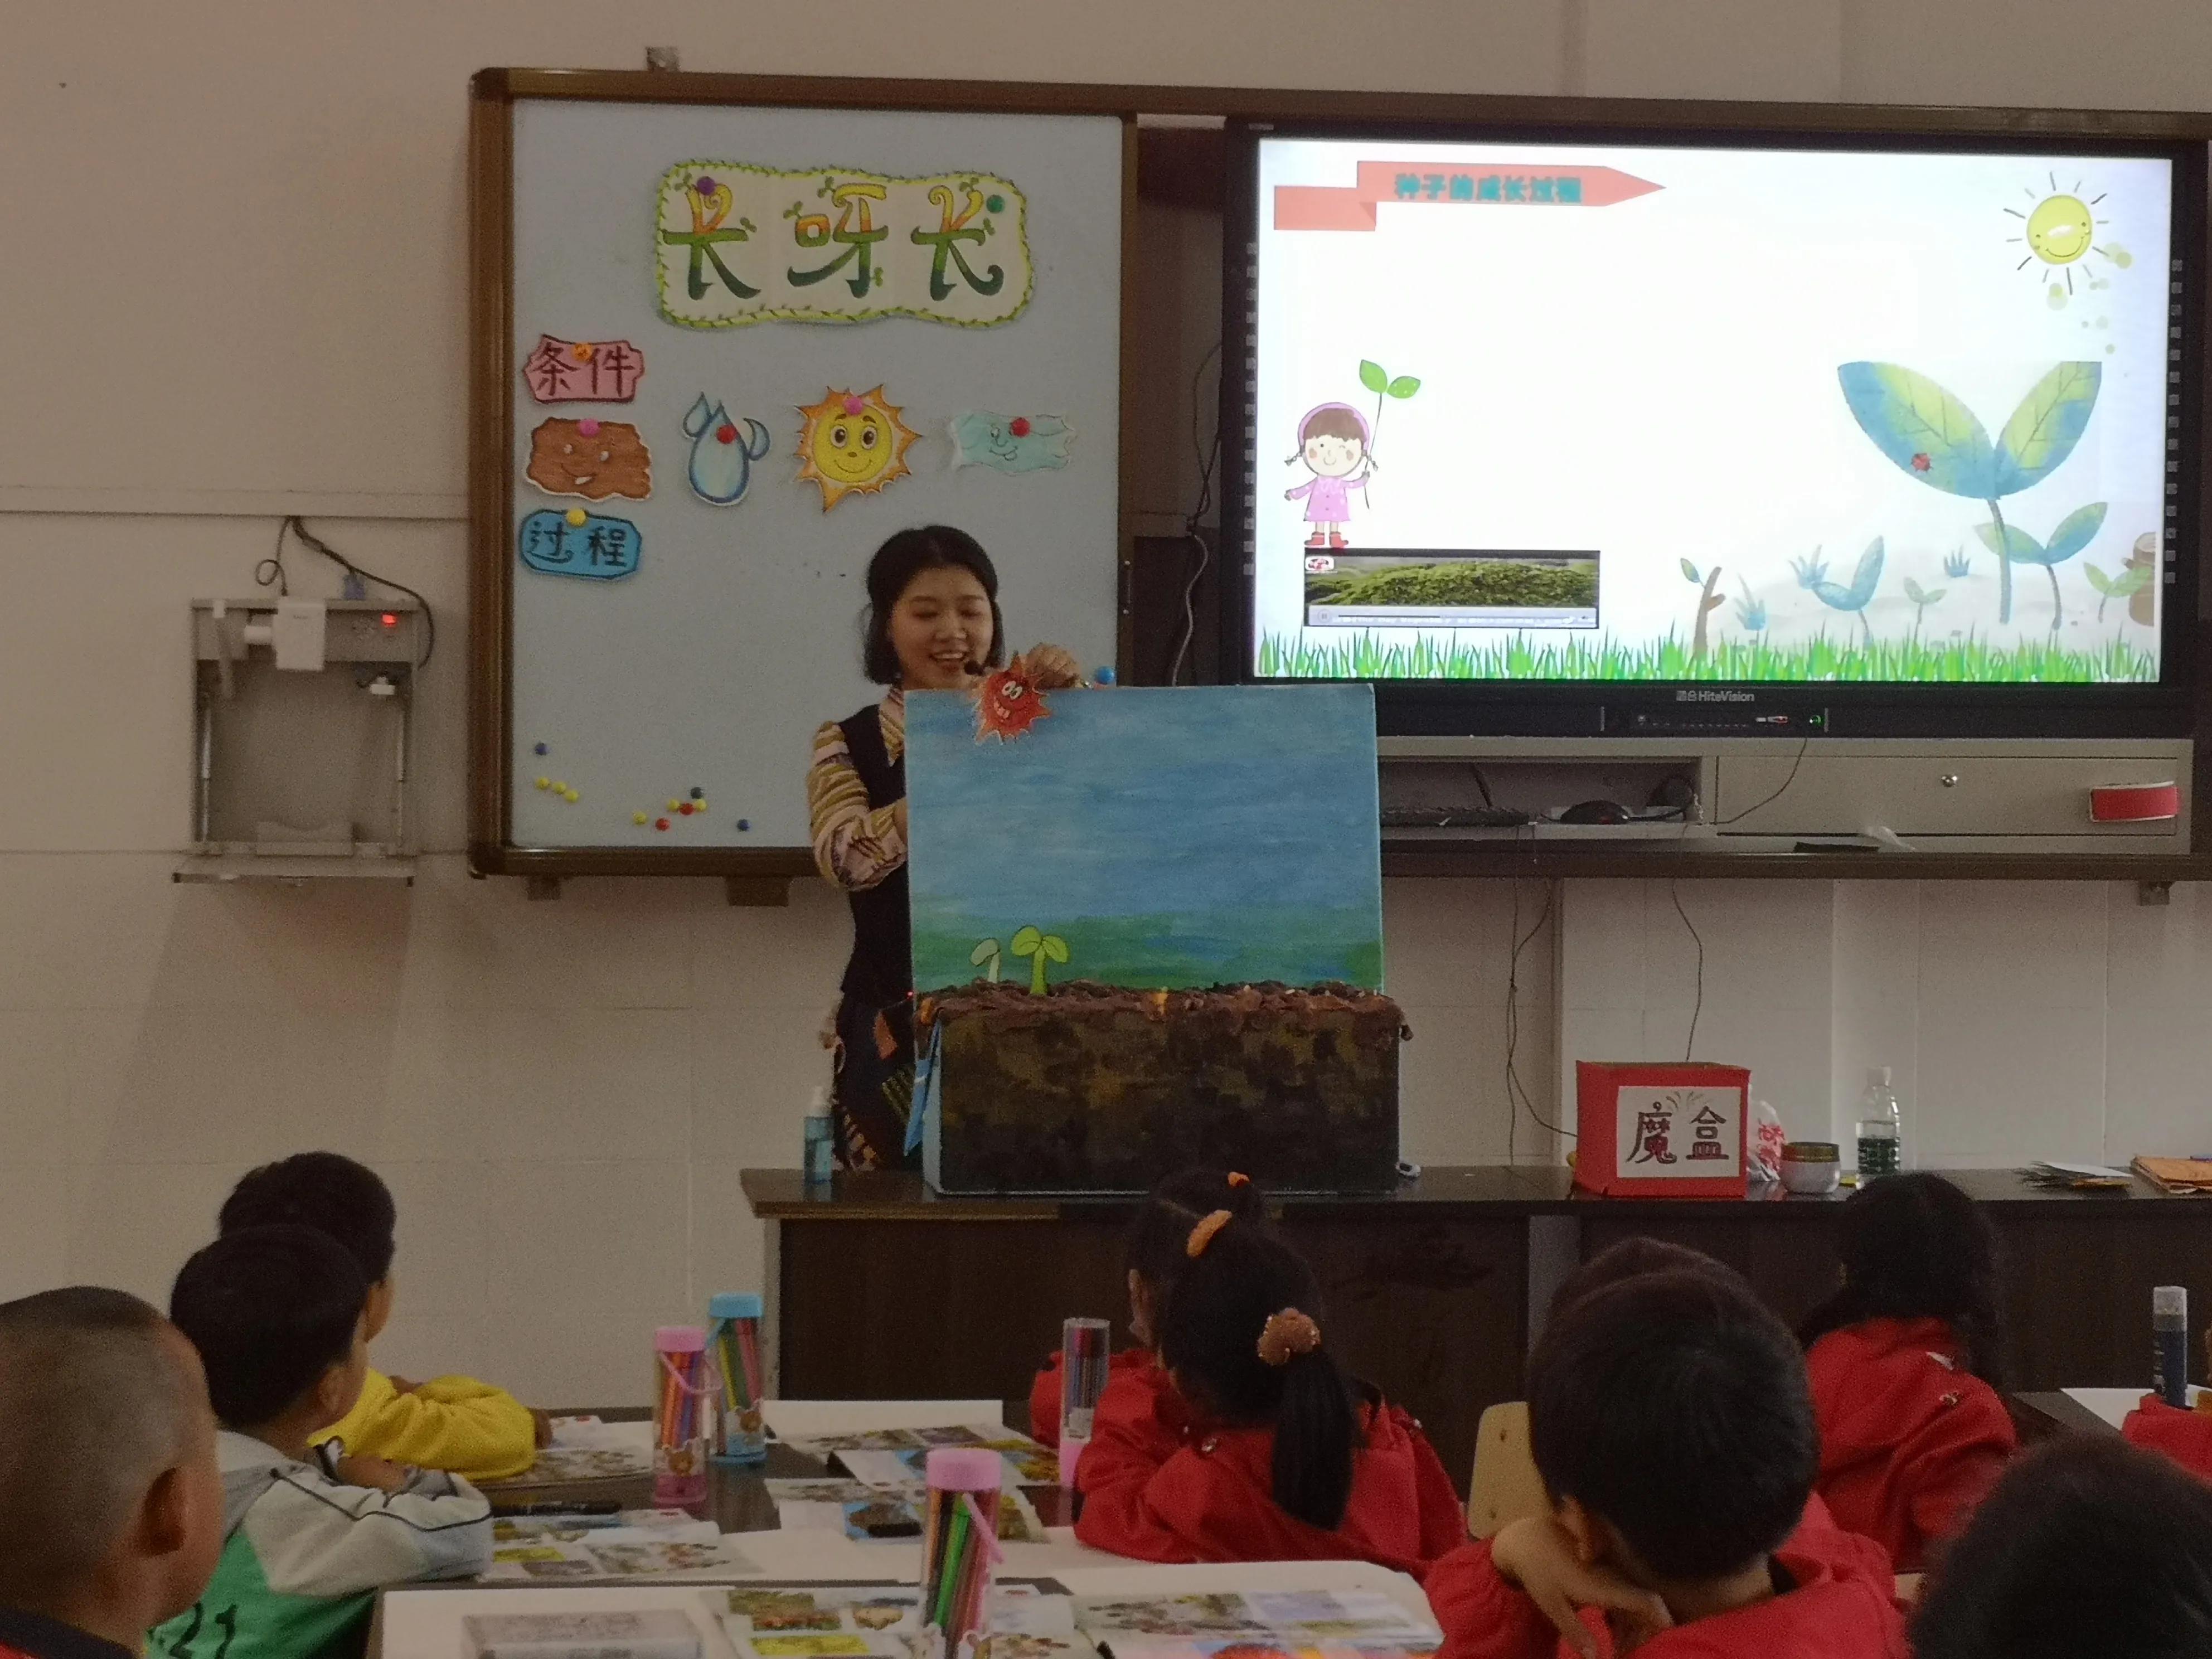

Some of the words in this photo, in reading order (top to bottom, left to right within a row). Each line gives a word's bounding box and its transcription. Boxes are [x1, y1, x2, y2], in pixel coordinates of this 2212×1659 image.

[662, 183, 1005, 302] 长呀长
[531, 341, 636, 397] 条件
[526, 521, 628, 567] 过程
[1625, 1100, 1729, 1165] 魔盒
